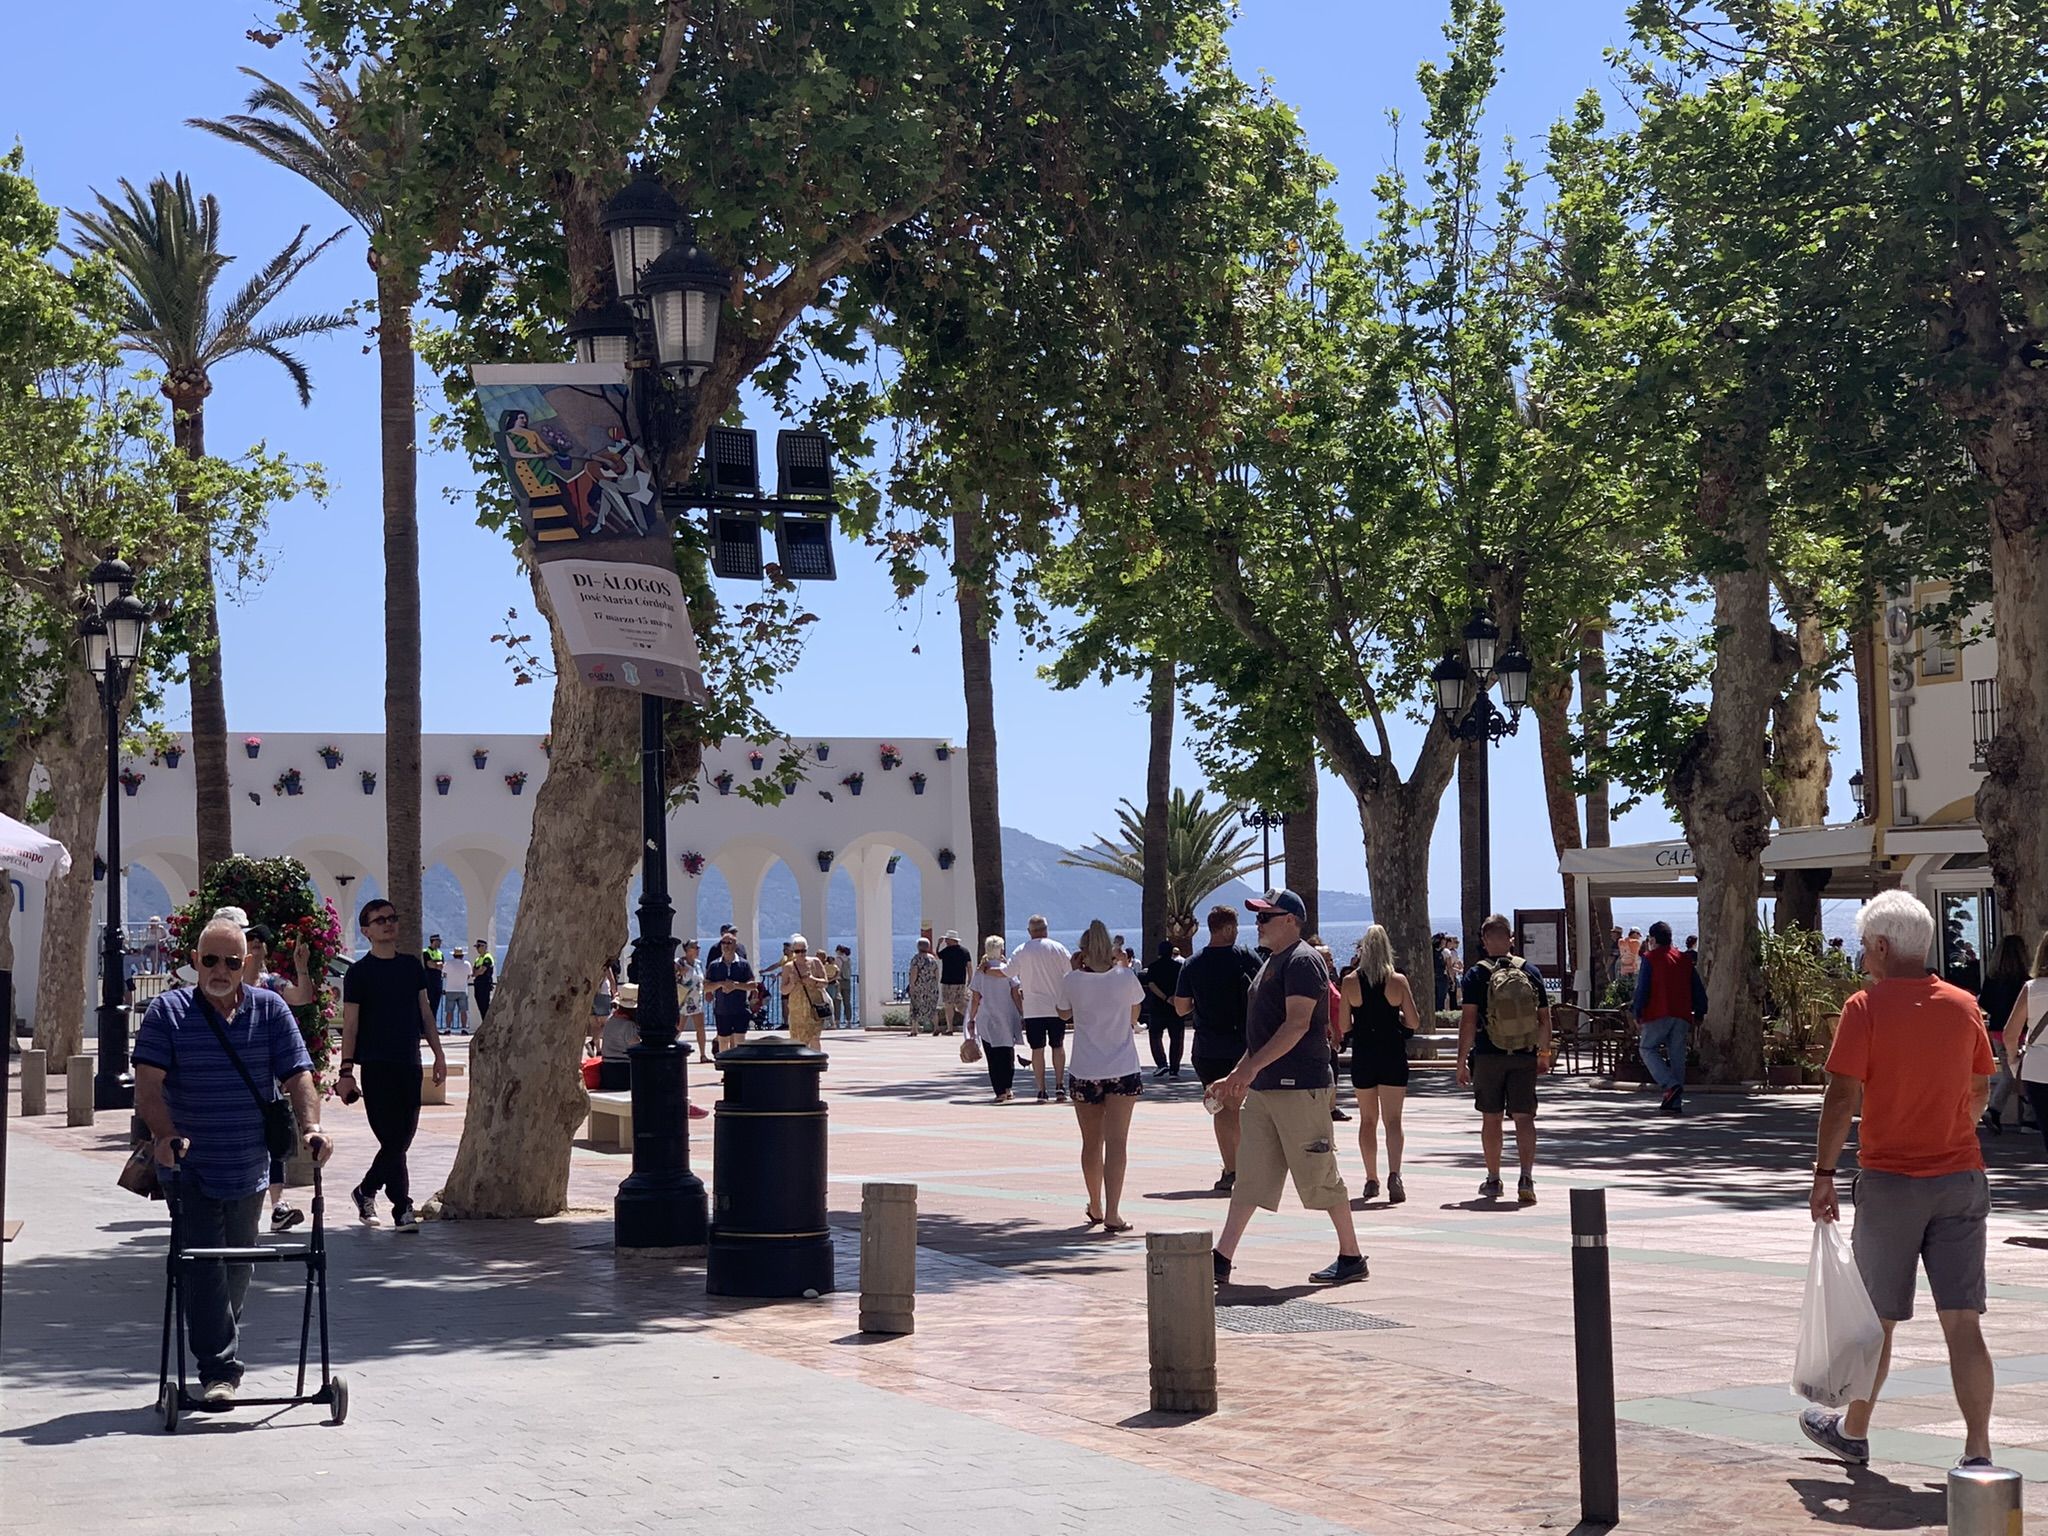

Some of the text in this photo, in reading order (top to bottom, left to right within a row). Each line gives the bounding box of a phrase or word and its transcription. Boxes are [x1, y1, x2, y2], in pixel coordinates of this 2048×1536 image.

[572, 573, 671, 596] DI-ÁLOGOS
[580, 592, 601, 602] José
[603, 594, 633, 605] María
